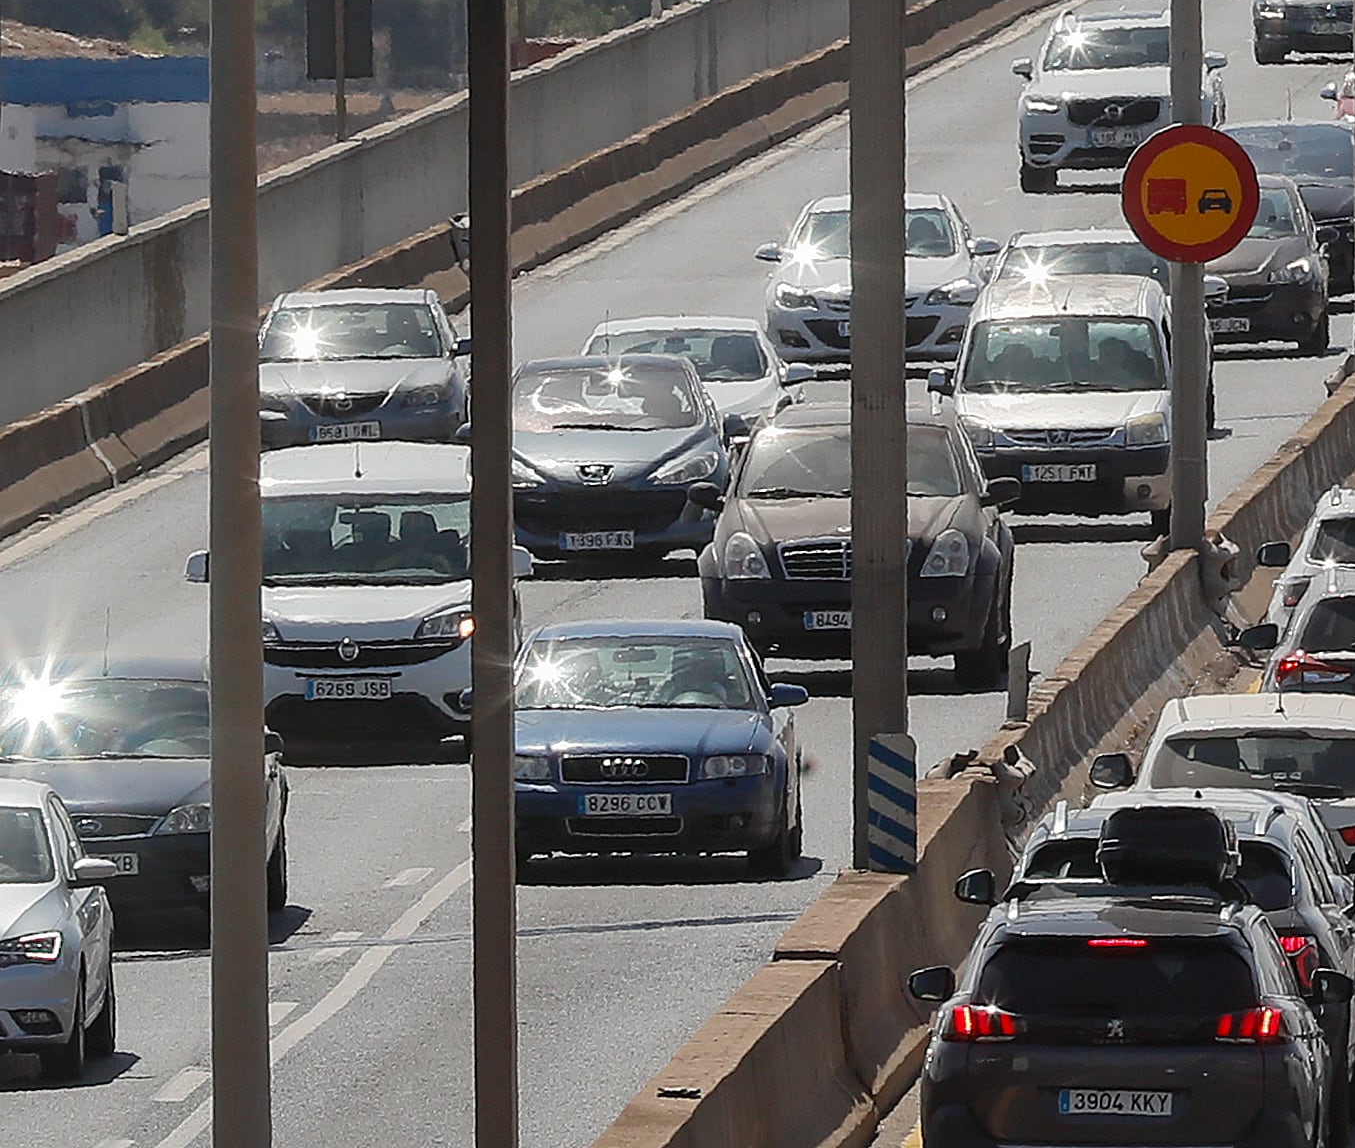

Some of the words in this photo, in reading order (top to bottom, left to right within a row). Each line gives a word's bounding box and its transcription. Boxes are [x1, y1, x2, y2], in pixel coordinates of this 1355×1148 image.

[360, 682, 389, 697] JSB
[588, 796, 631, 811] 8296
[1074, 1093, 1124, 1111] 3904
[1130, 1093, 1169, 1112] KKY
